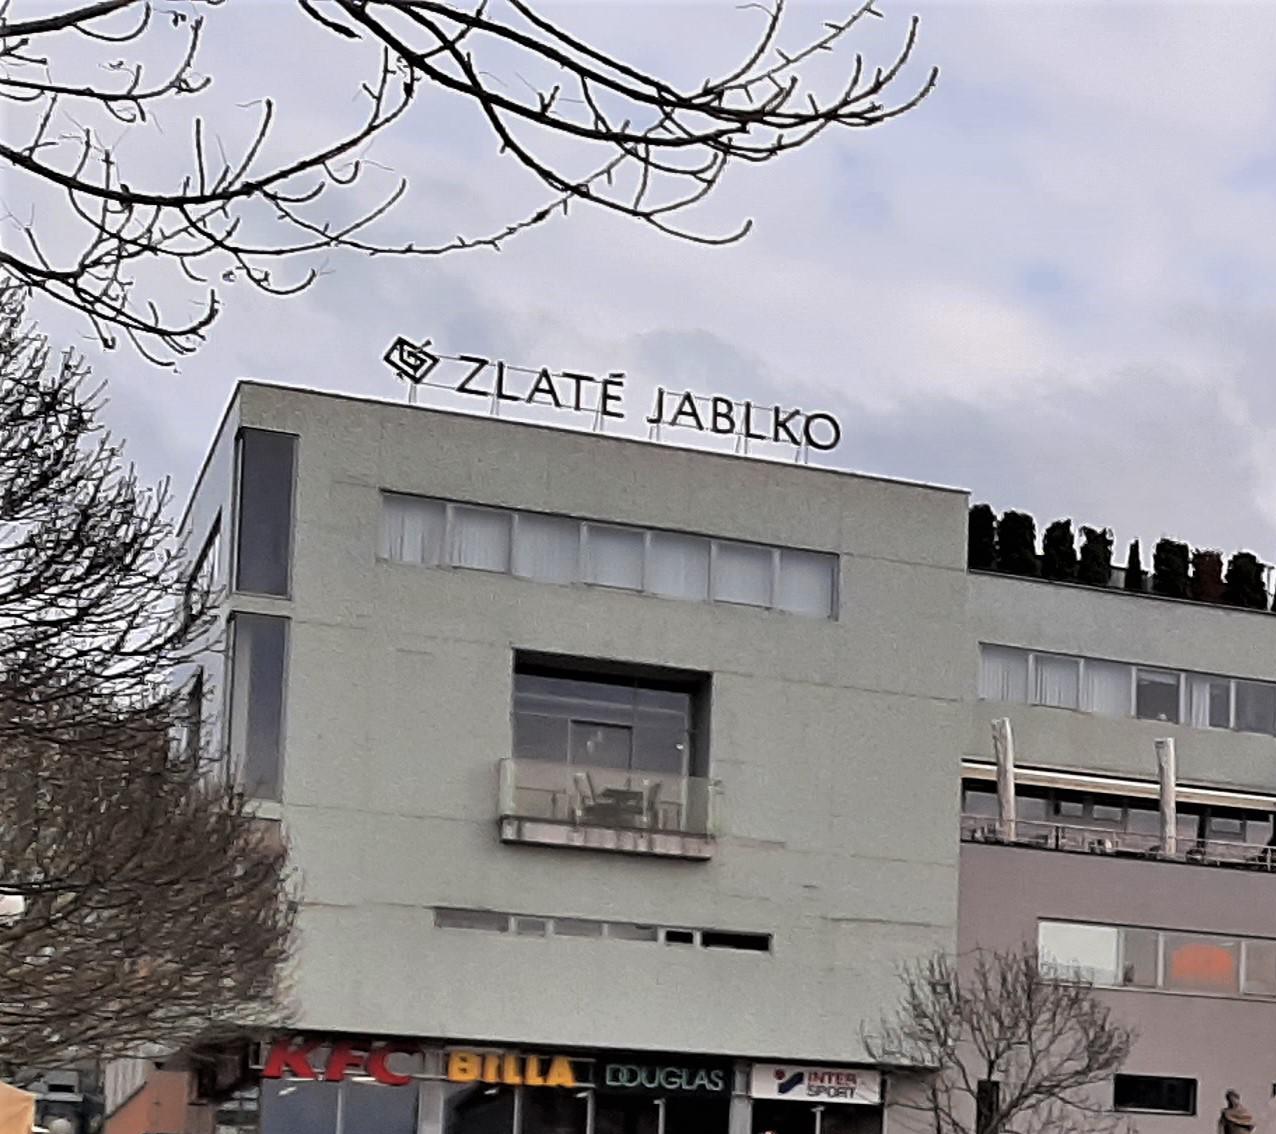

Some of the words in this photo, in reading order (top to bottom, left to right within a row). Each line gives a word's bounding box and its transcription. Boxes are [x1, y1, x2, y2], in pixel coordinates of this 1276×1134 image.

[455, 354, 625, 419] ZLATÉ
[647, 386, 841, 451] JABLKO
[262, 1036, 421, 1087] KFC
[448, 1050, 577, 1088] BILLA
[606, 1063, 724, 1092] DOUGLAS
